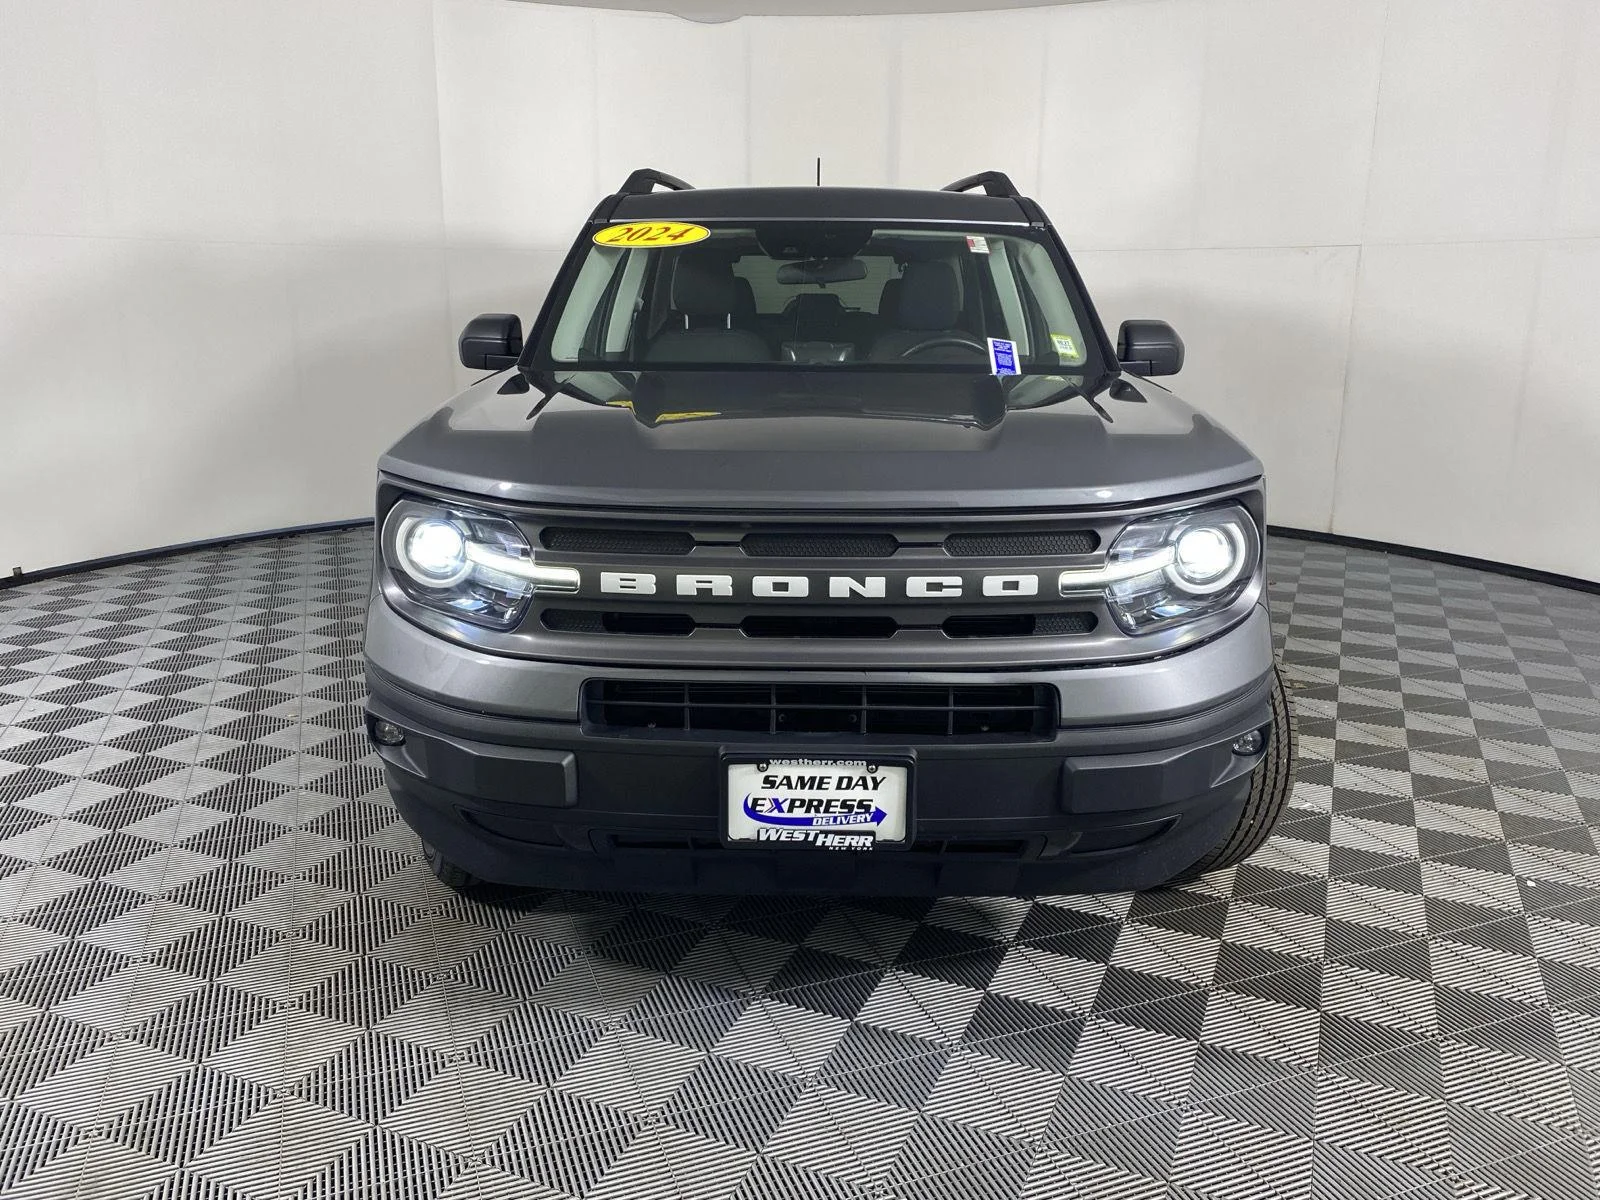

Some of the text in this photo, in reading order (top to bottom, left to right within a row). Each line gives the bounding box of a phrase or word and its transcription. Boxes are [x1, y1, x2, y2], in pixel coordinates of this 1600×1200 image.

[606, 226, 696, 242] 2024
[600, 571, 1039, 598] BRONCO
[769, 758, 867, 767] westherr.com
[761, 775, 887, 790] SAME DAY
[750, 798, 874, 814] EXPRESS
[812, 813, 875, 826] DELIVERY
